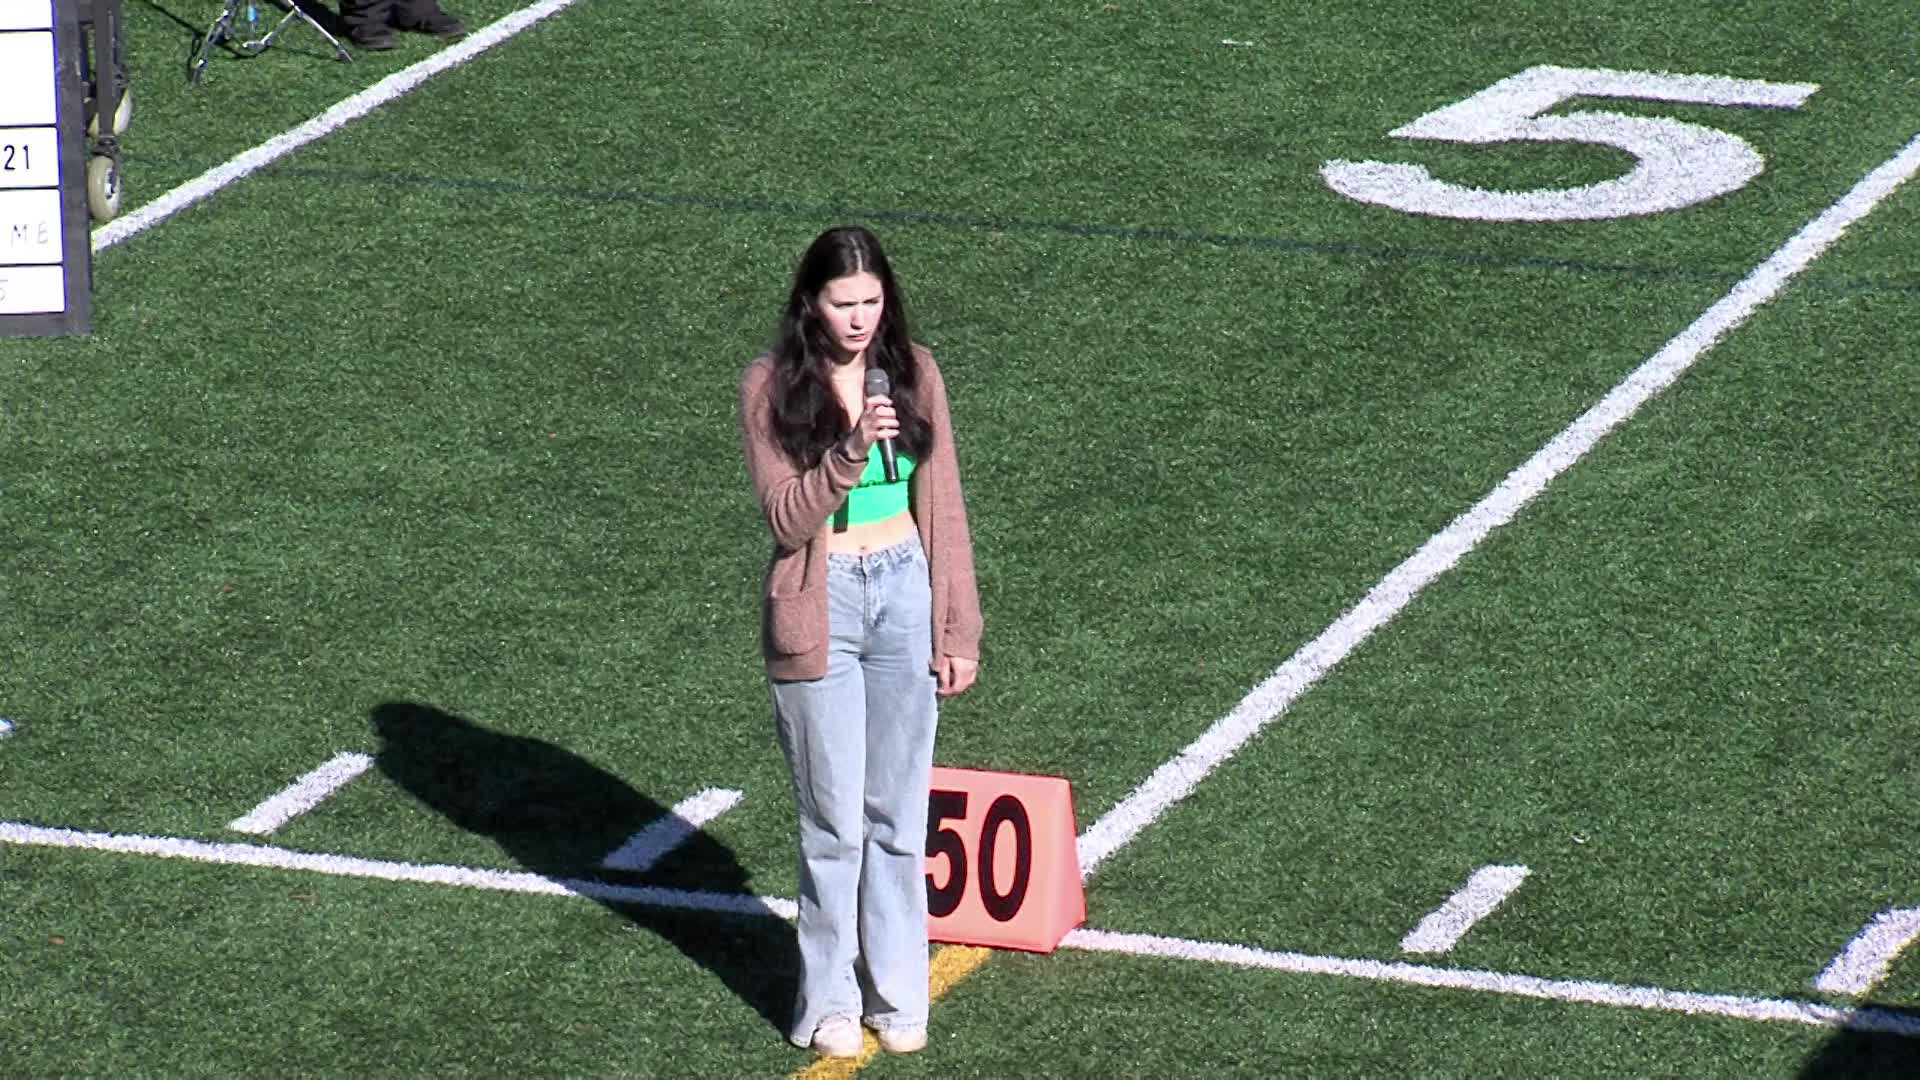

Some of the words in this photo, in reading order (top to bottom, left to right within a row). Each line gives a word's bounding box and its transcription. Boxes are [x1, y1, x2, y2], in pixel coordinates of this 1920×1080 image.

[3, 144, 30, 170] 21
[1319, 64, 1820, 222] 5
[925, 789, 1032, 922] 50
